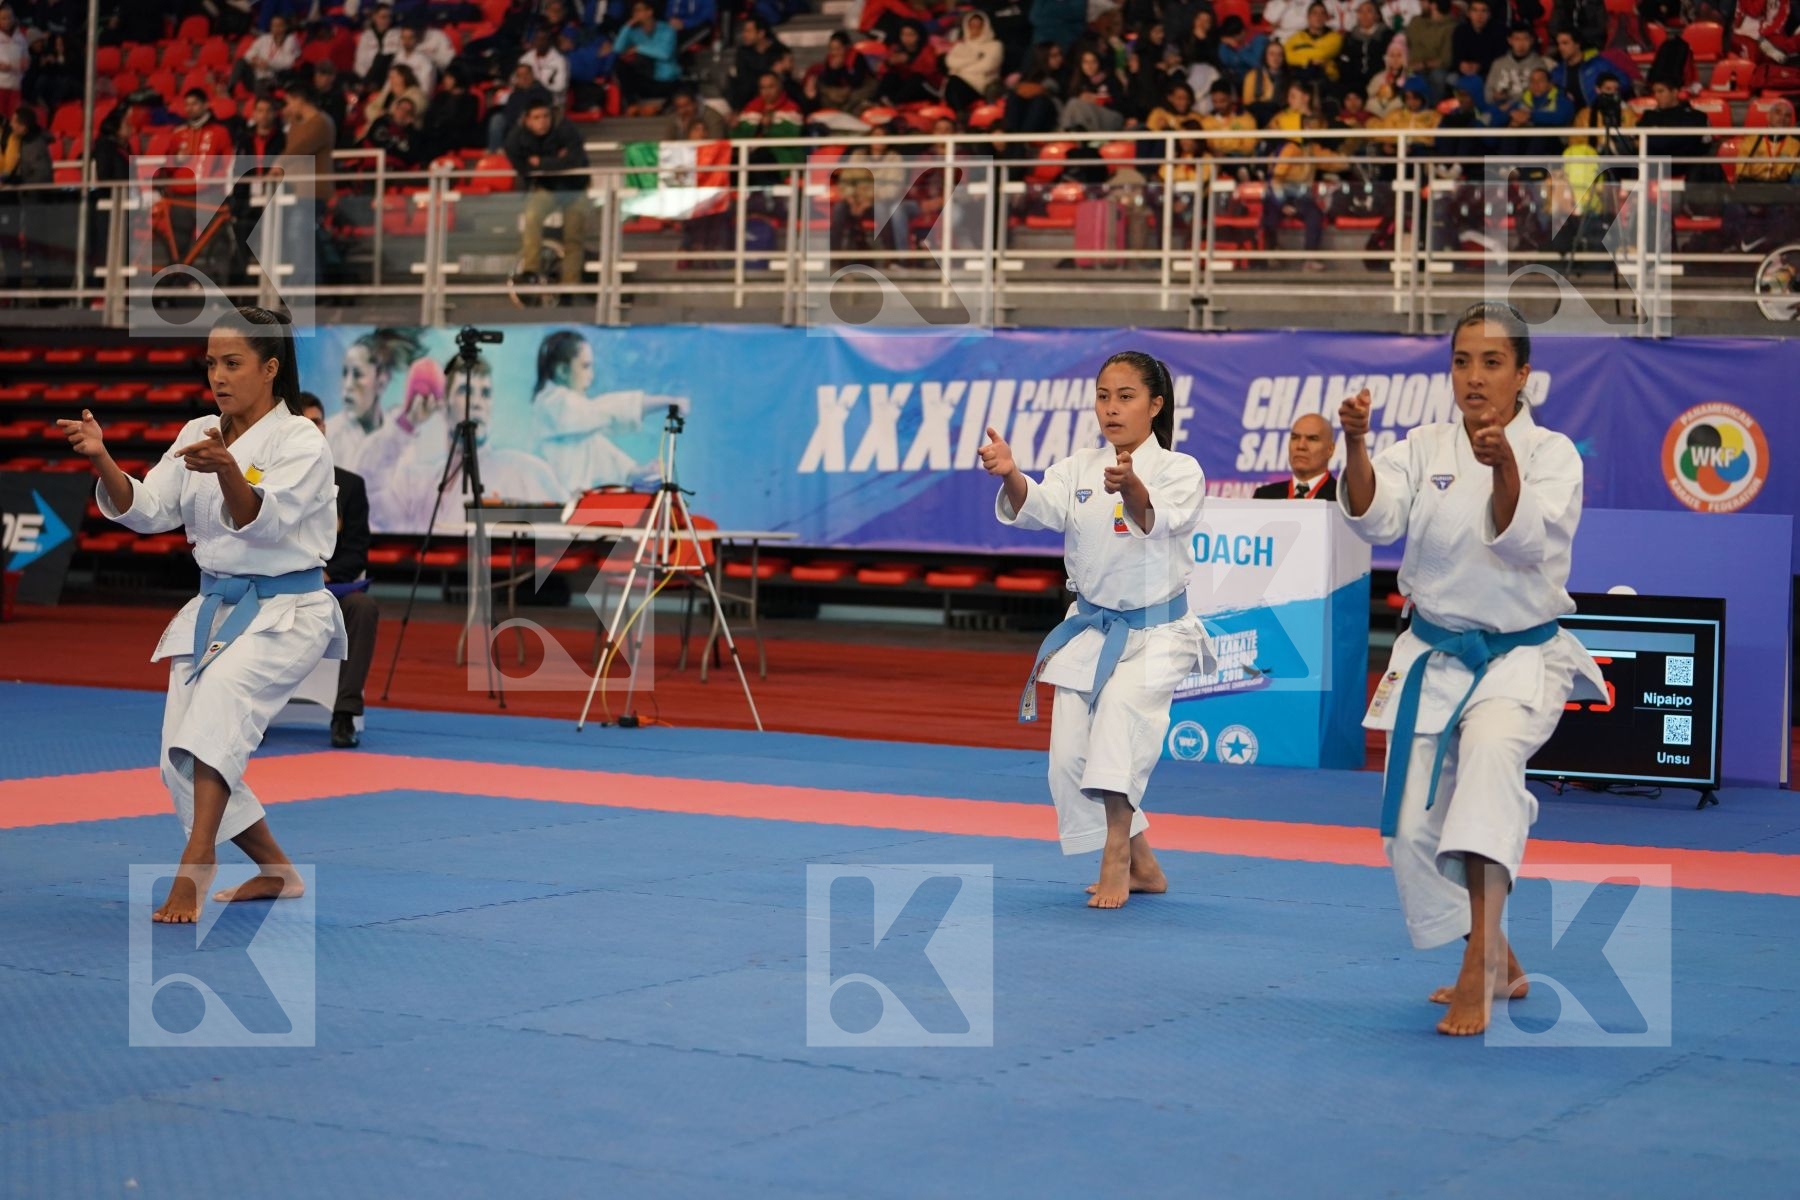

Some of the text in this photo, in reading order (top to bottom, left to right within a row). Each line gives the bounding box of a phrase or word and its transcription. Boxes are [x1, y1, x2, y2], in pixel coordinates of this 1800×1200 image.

[1690, 446, 1735, 468] WKF
[1192, 532, 1273, 567] OACH
[1643, 692, 1693, 708] Nipaipo
[1656, 751, 1690, 765] Unsu
